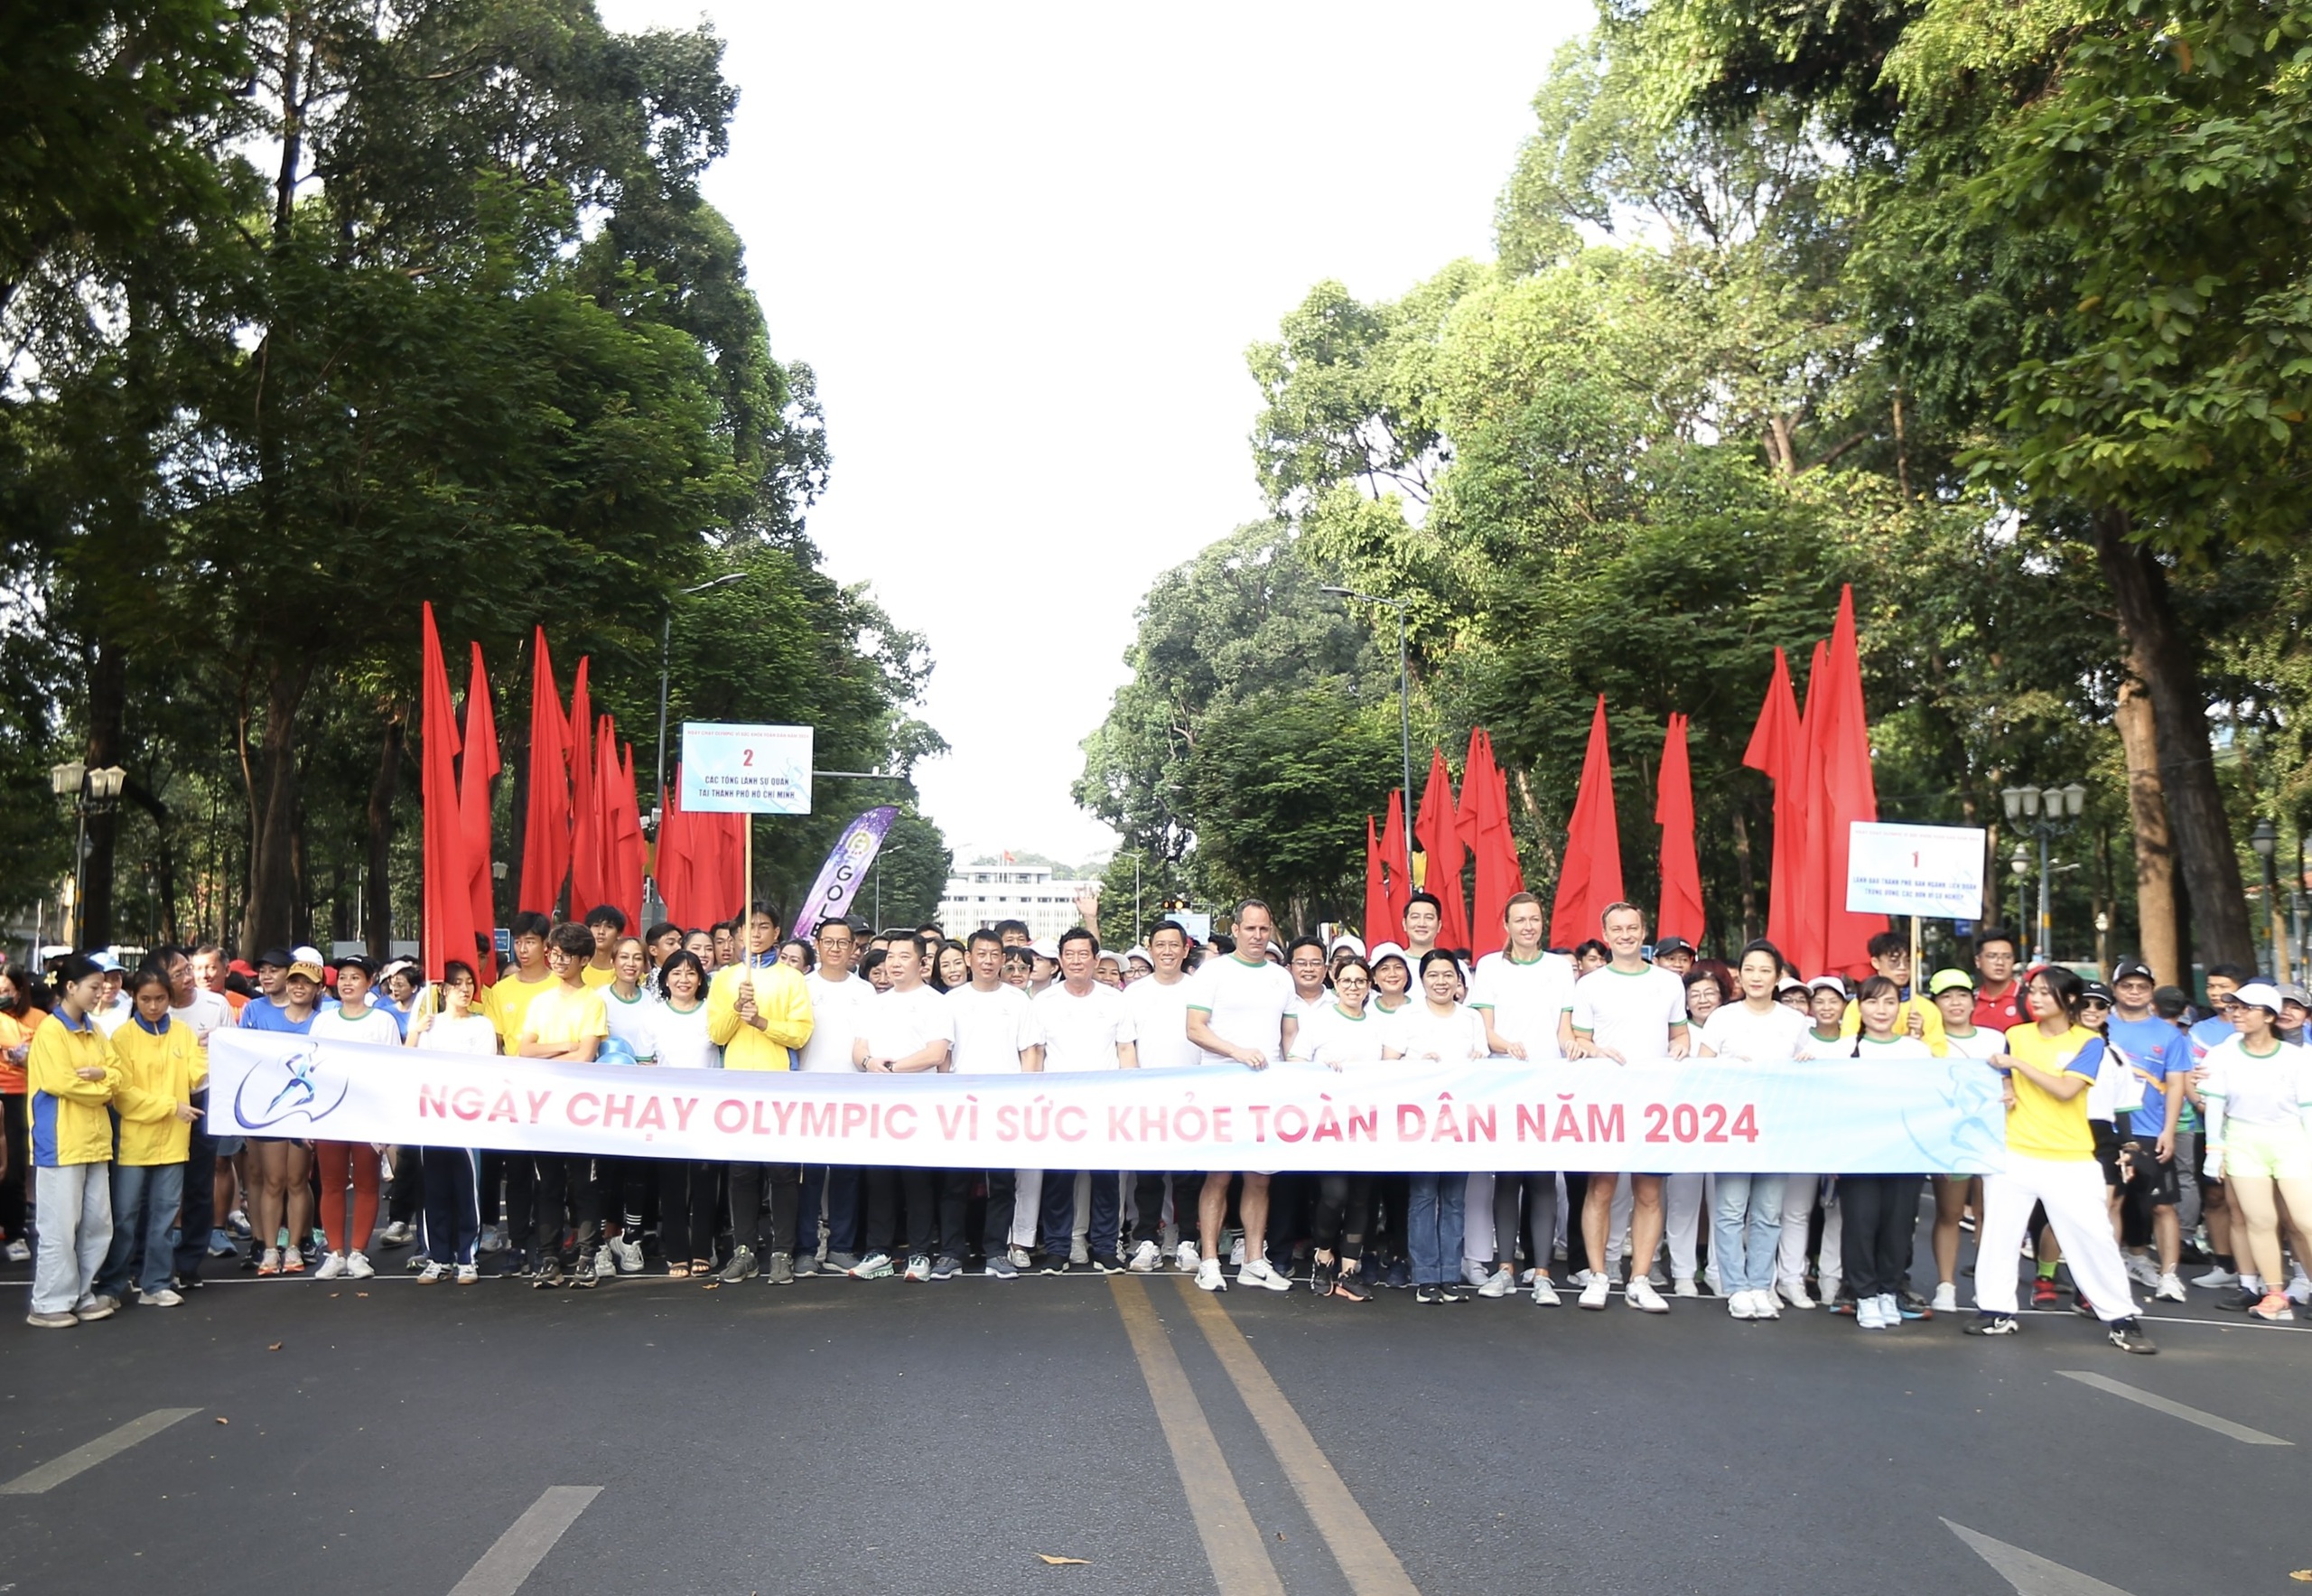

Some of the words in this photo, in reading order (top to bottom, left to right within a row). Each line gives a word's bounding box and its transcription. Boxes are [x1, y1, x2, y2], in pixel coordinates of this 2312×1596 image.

[742, 749, 753, 767] 2
[777, 790, 795, 799] MINH
[1912, 851, 1918, 868] 1
[418, 1080, 553, 1125] NGÀY
[565, 1091, 699, 1141] CHẠY
[714, 1098, 918, 1140] OLYMPIC
[936, 1094, 978, 1141] VÌ
[996, 1095, 1086, 1142] SỨC
[1108, 1091, 1233, 1143] KHỎE
[1247, 1093, 1378, 1143] TOÀN
[1395, 1091, 1497, 1143] DÂN
[1515, 1093, 1626, 1143] NĂM
[1643, 1102, 1760, 1144] 2024
